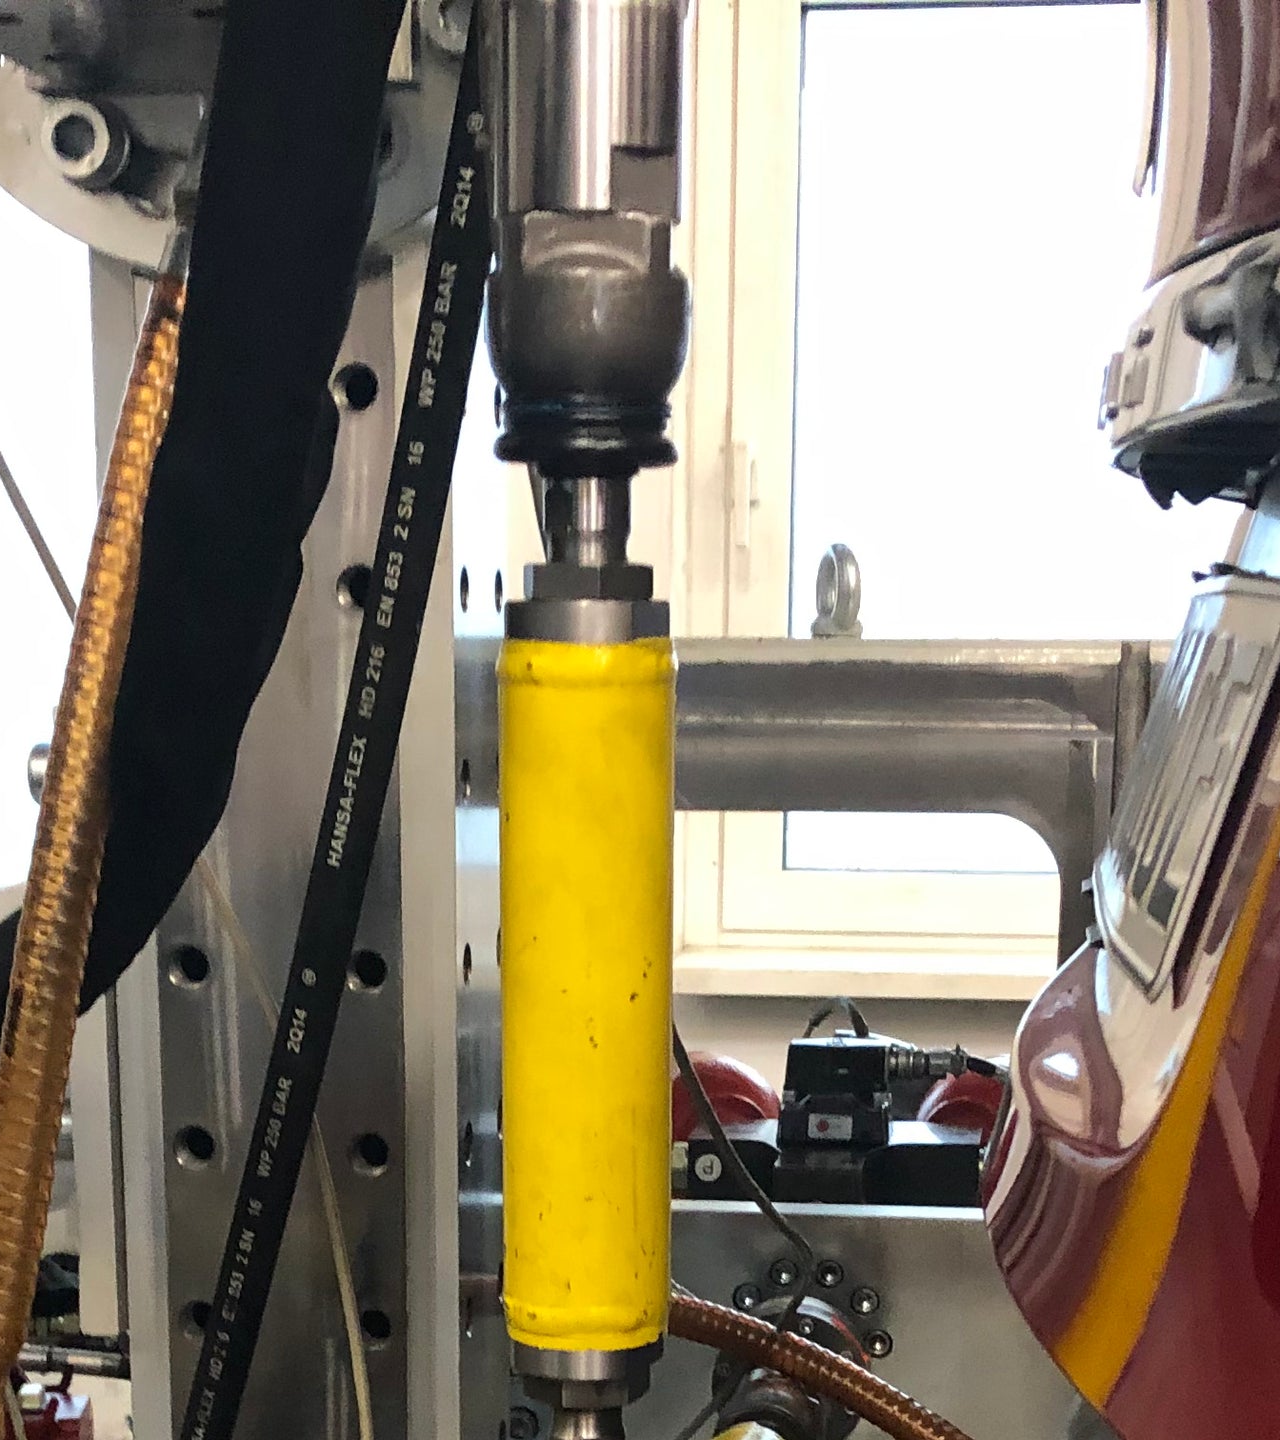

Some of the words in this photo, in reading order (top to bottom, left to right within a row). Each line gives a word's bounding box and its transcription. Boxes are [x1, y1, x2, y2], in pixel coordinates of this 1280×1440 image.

[433, 260, 458, 316] BAR
[426, 319, 446, 364] 250
[418, 367, 436, 409] WP
[407, 440, 425, 465] 16
[397, 486, 416, 521] SN
[393, 523, 409, 541] 2
[384, 551, 404, 591] 853
[376, 595, 395, 629] EN
[366, 643, 386, 684] 216
[358, 686, 376, 720] HD
[326, 734, 368, 868] HANSA-FLEX
